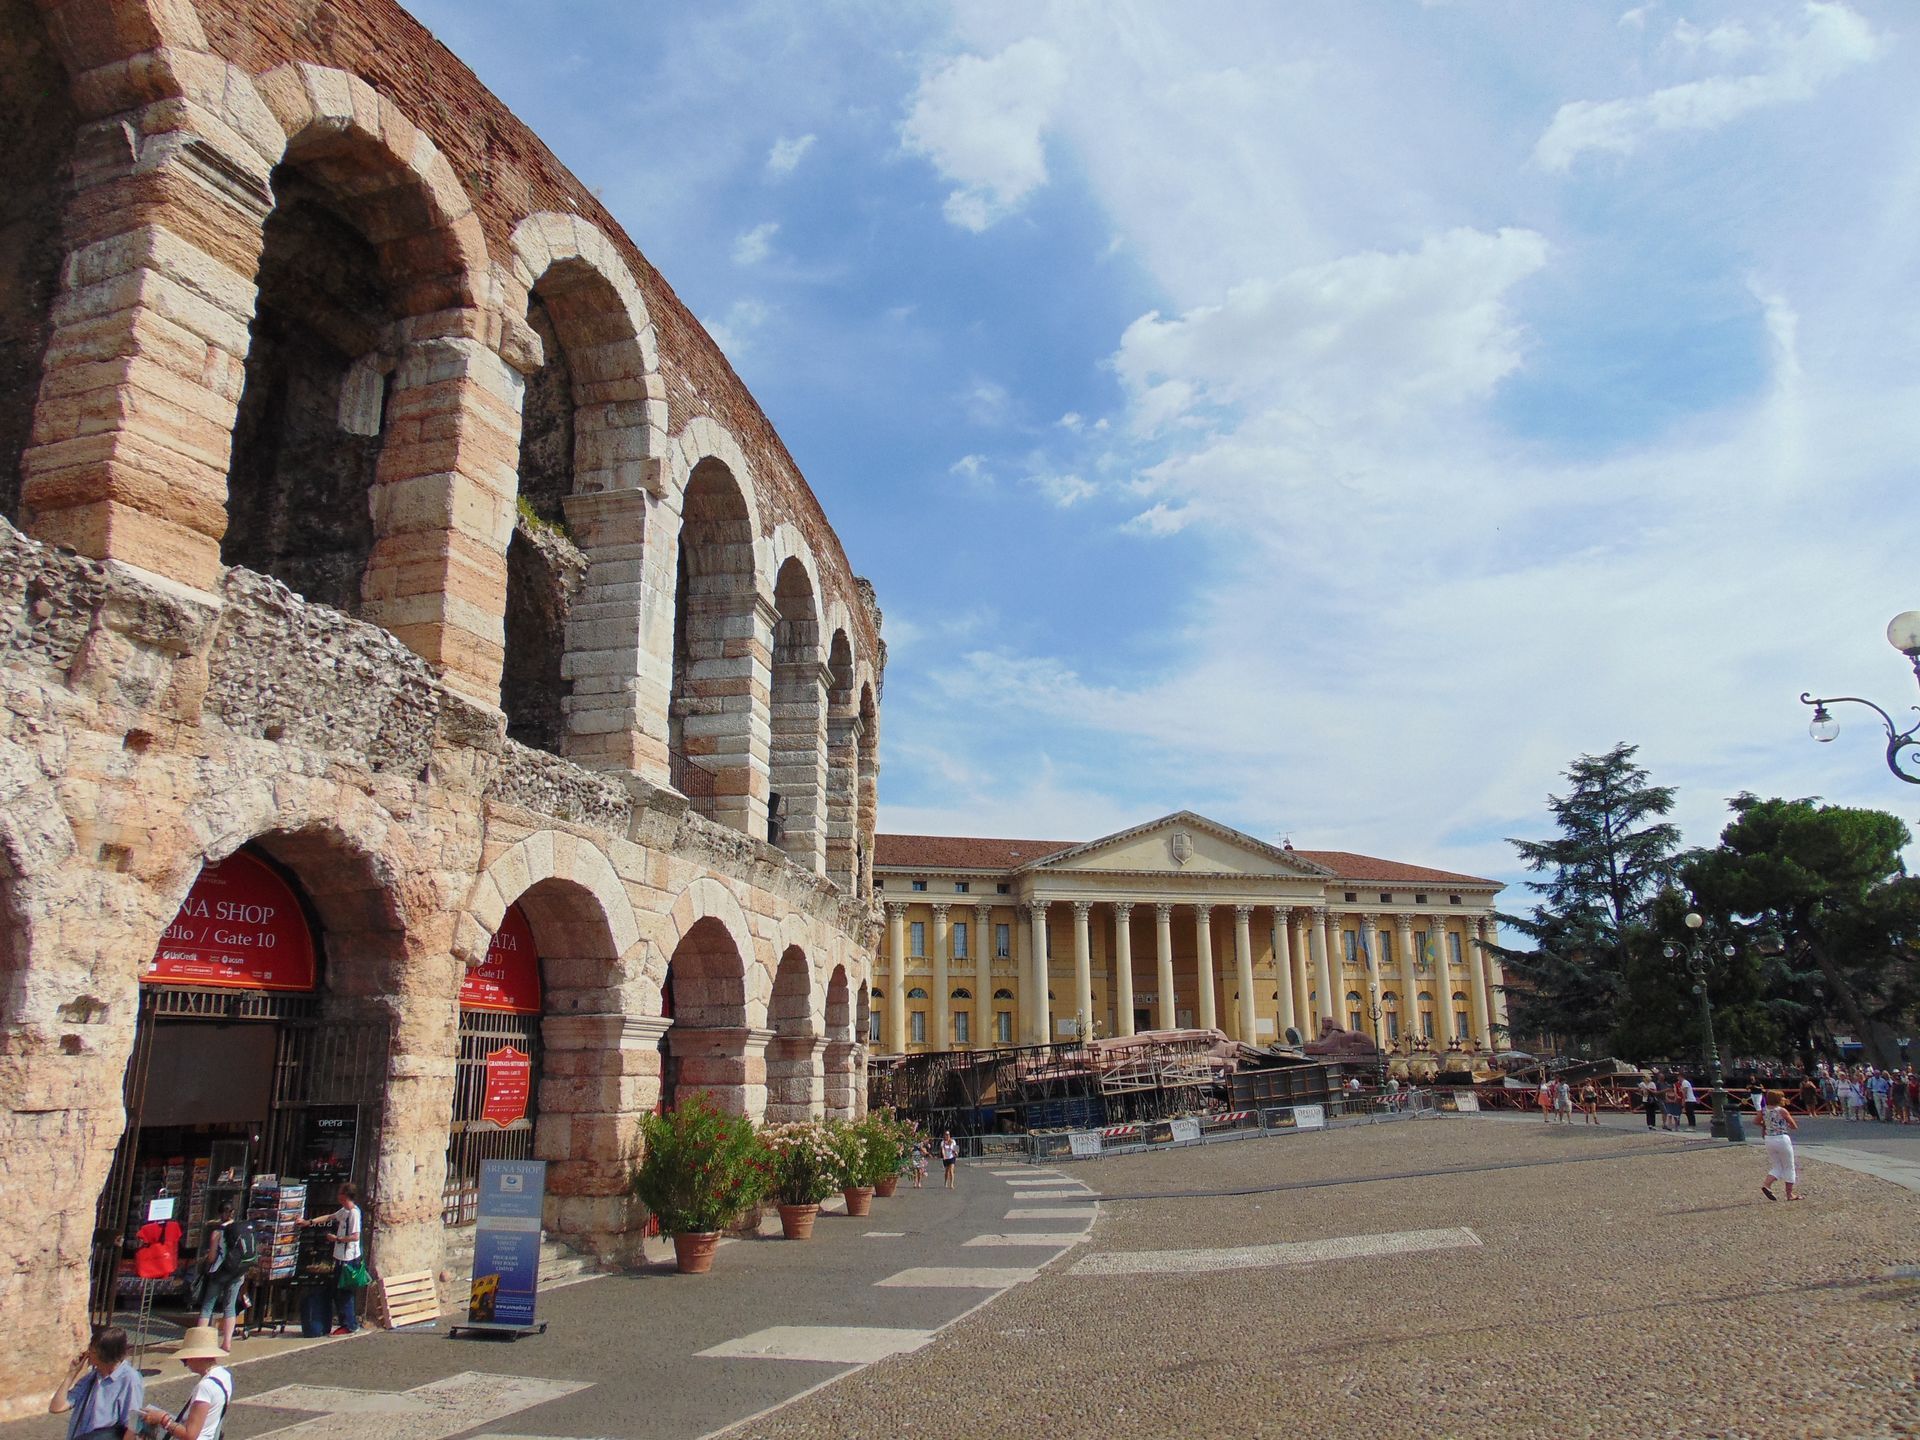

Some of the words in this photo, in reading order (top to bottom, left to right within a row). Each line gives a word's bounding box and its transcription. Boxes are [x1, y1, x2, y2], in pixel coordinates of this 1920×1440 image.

[215, 901, 275, 925] SHOP
[214, 929, 252, 946] Gate
[257, 933, 276, 949] 10
[169, 951, 198, 961] UniCredit
[477, 968, 495, 979] Gate
[496, 969, 506, 980] 11
[485, 1164, 515, 1174] ARENA
[517, 1165, 542, 1174] SHOP
